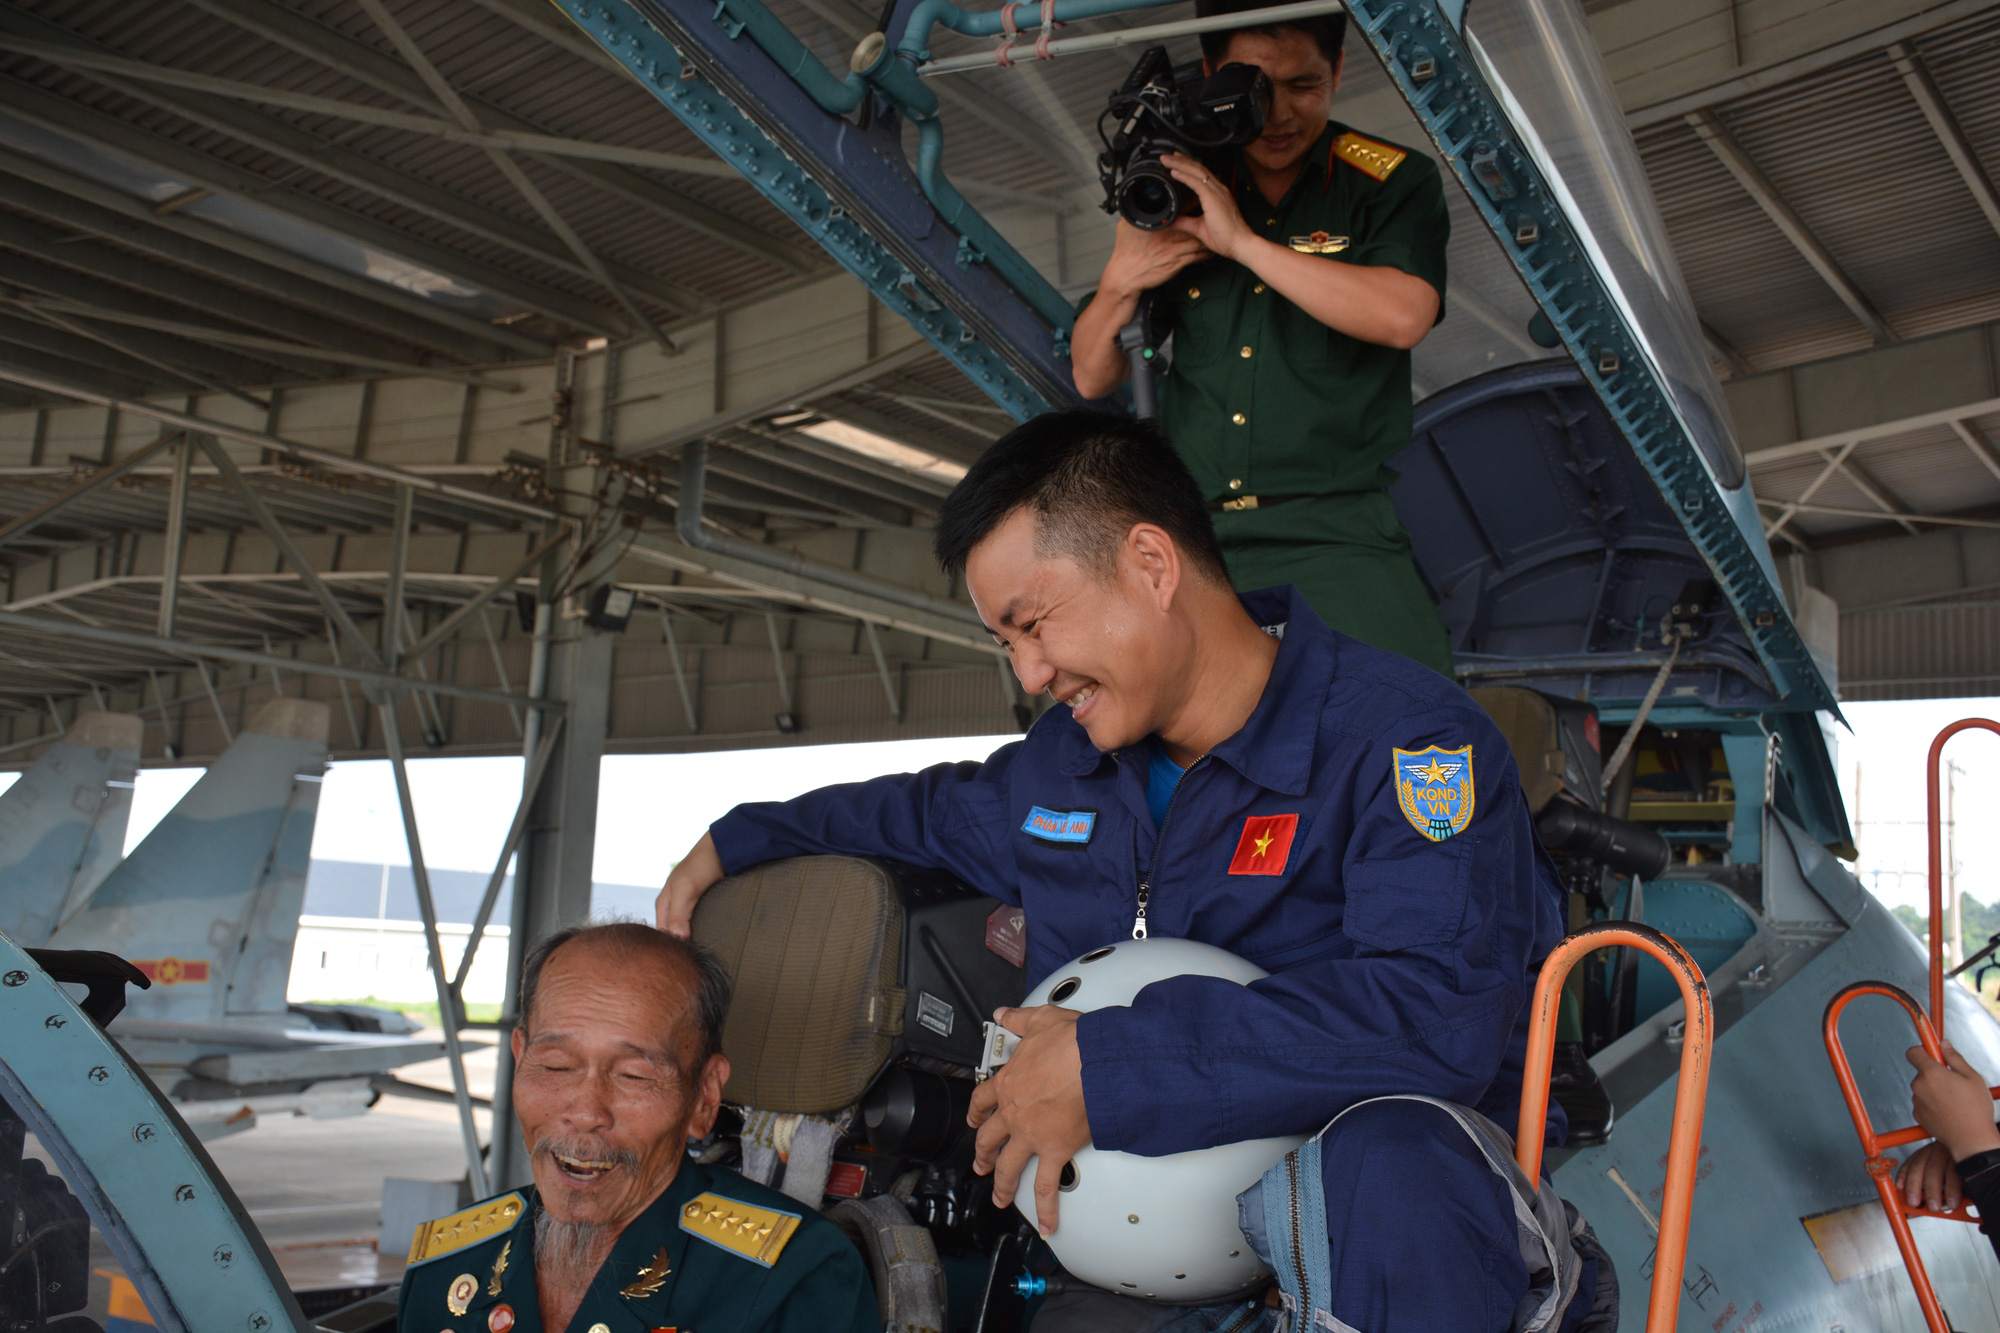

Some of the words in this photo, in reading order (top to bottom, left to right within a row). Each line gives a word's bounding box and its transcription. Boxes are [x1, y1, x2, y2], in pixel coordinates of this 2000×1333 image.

[1213, 102, 1235, 113] SONY
[1416, 788, 1458, 801] KQND
[1426, 801, 1451, 816] VN
[1069, 820, 1089, 835] ANH
